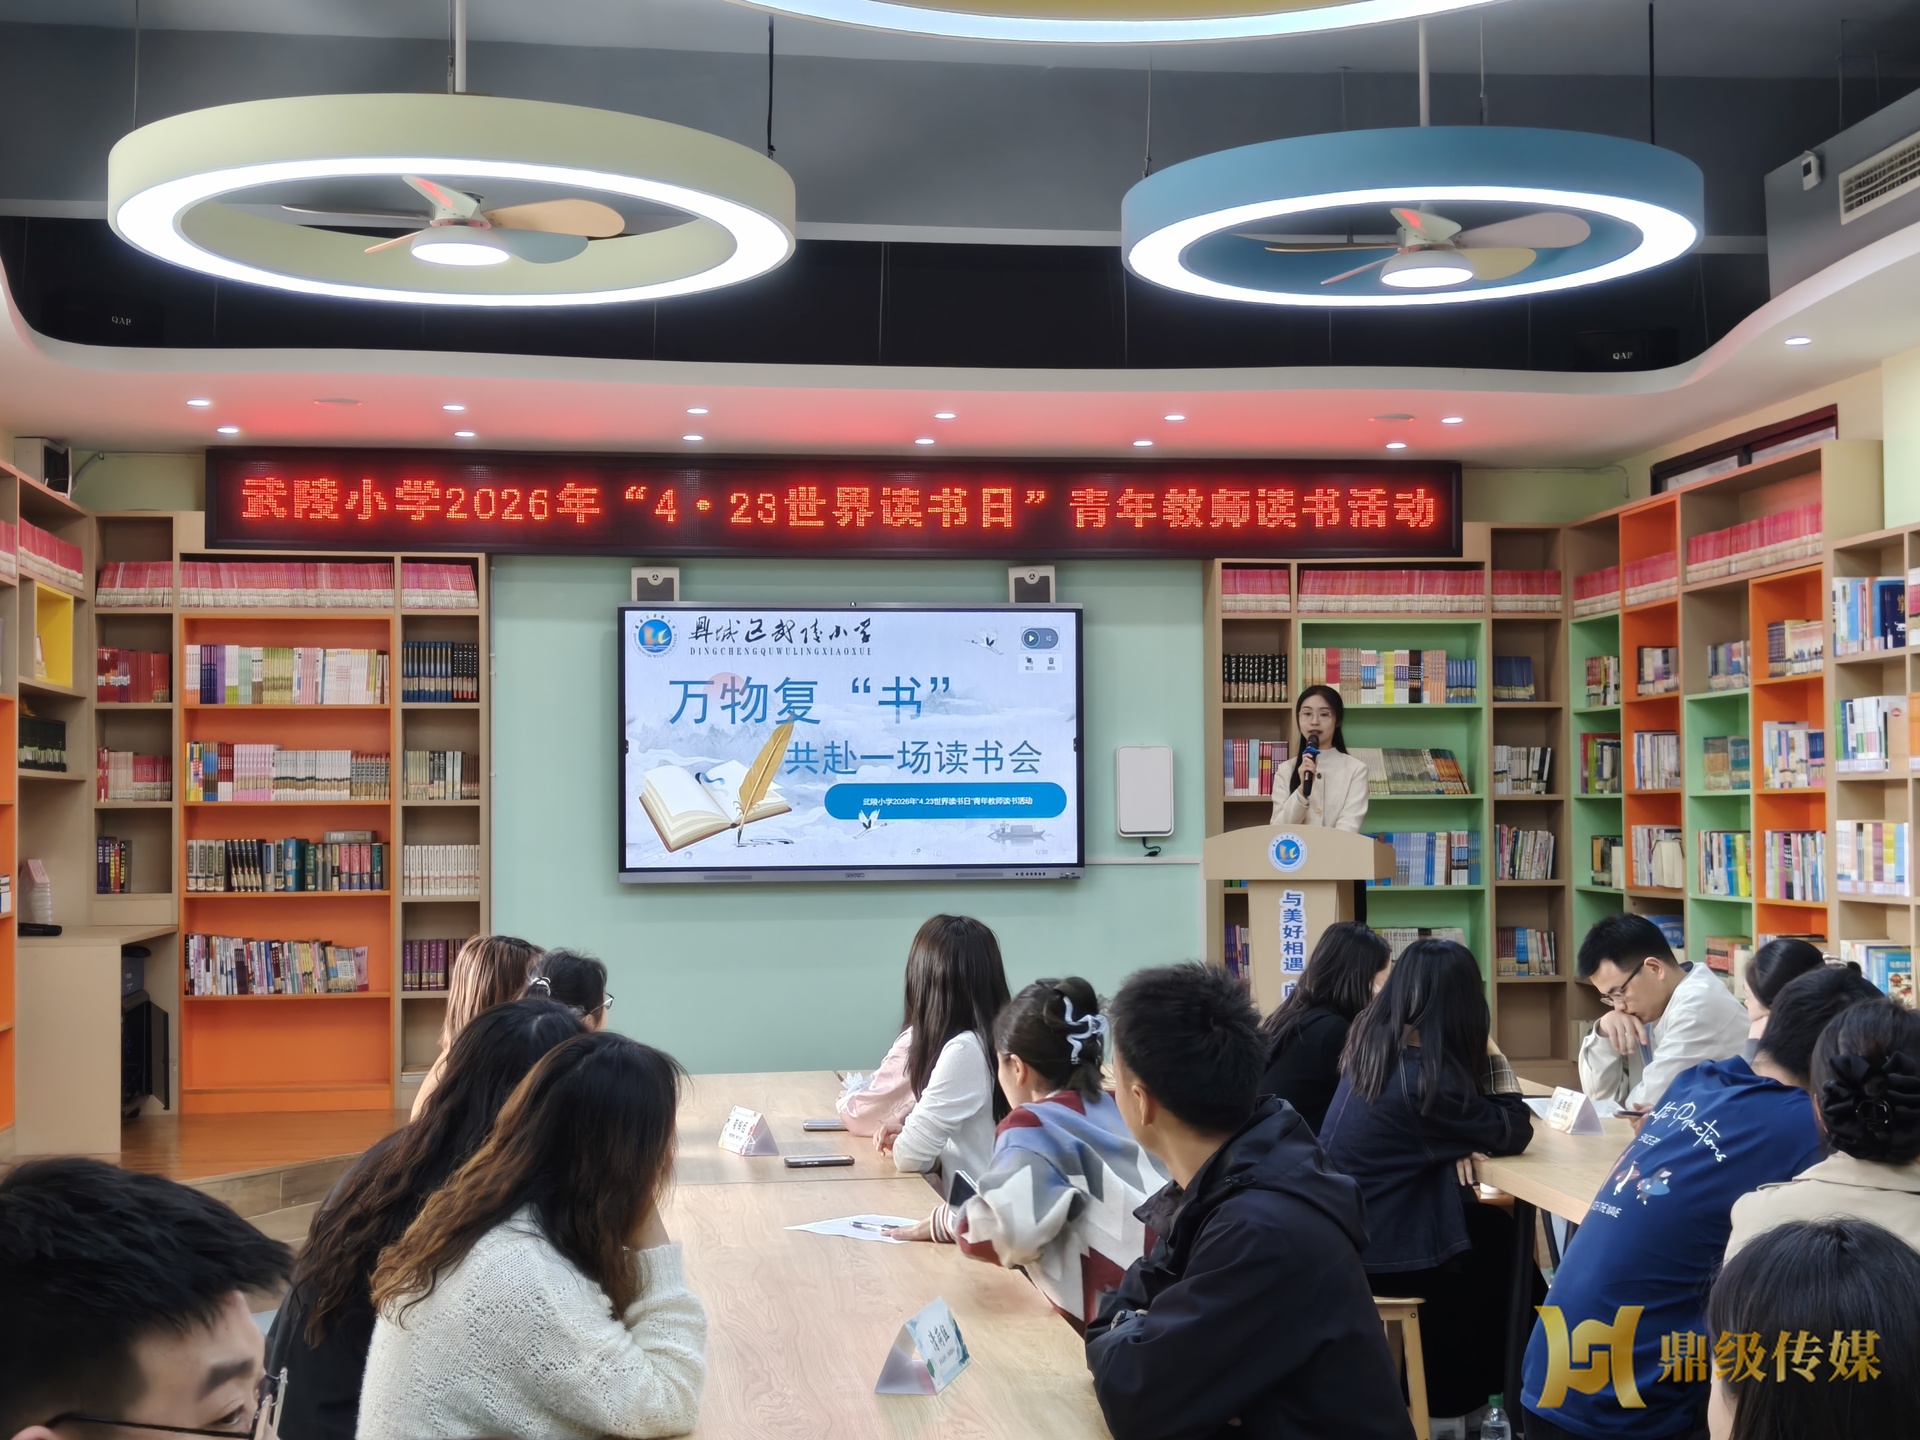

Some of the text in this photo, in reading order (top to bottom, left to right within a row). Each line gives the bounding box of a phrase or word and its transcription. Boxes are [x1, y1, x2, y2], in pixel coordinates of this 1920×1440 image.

[784, 739, 1043, 776] 共赴一场读书会
[1281, 891, 1305, 973] 与美好相遇
